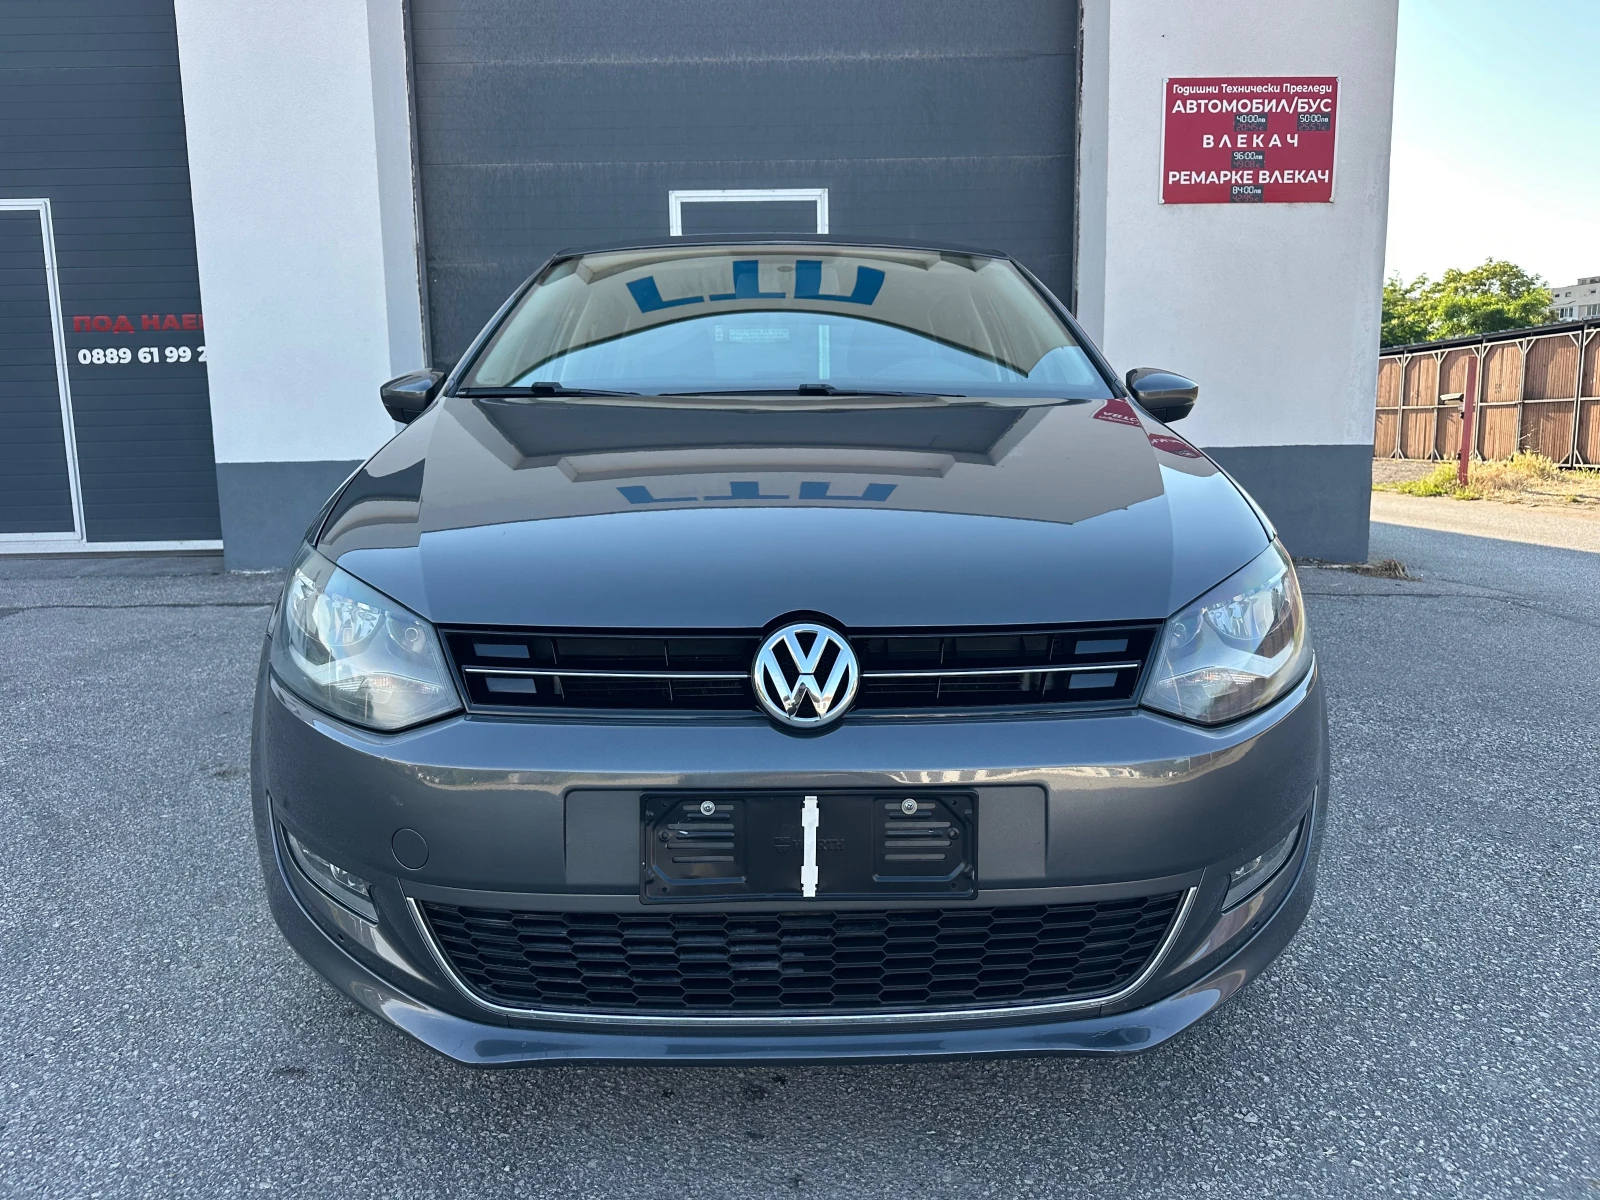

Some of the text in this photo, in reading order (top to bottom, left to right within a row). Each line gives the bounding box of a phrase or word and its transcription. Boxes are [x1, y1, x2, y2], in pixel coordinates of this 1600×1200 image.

[1172, 83, 1333, 96] Годишни Технически Прегледи
[1171, 97, 1332, 114] АВТОМОБИЛ/БУС
[1202, 133, 1299, 148] ВЛЕКАЧ
[1168, 170, 1330, 185] РЕМАРКЕ ВЛЕКАЧ
[73, 313, 205, 334] ПОД НАЕ
[77, 347, 132, 365] 0889
[137, 347, 160, 363] 61
[164, 346, 192, 363] 99
[755, 624, 858, 727] VW
[791, 838, 846, 852] WRTH
